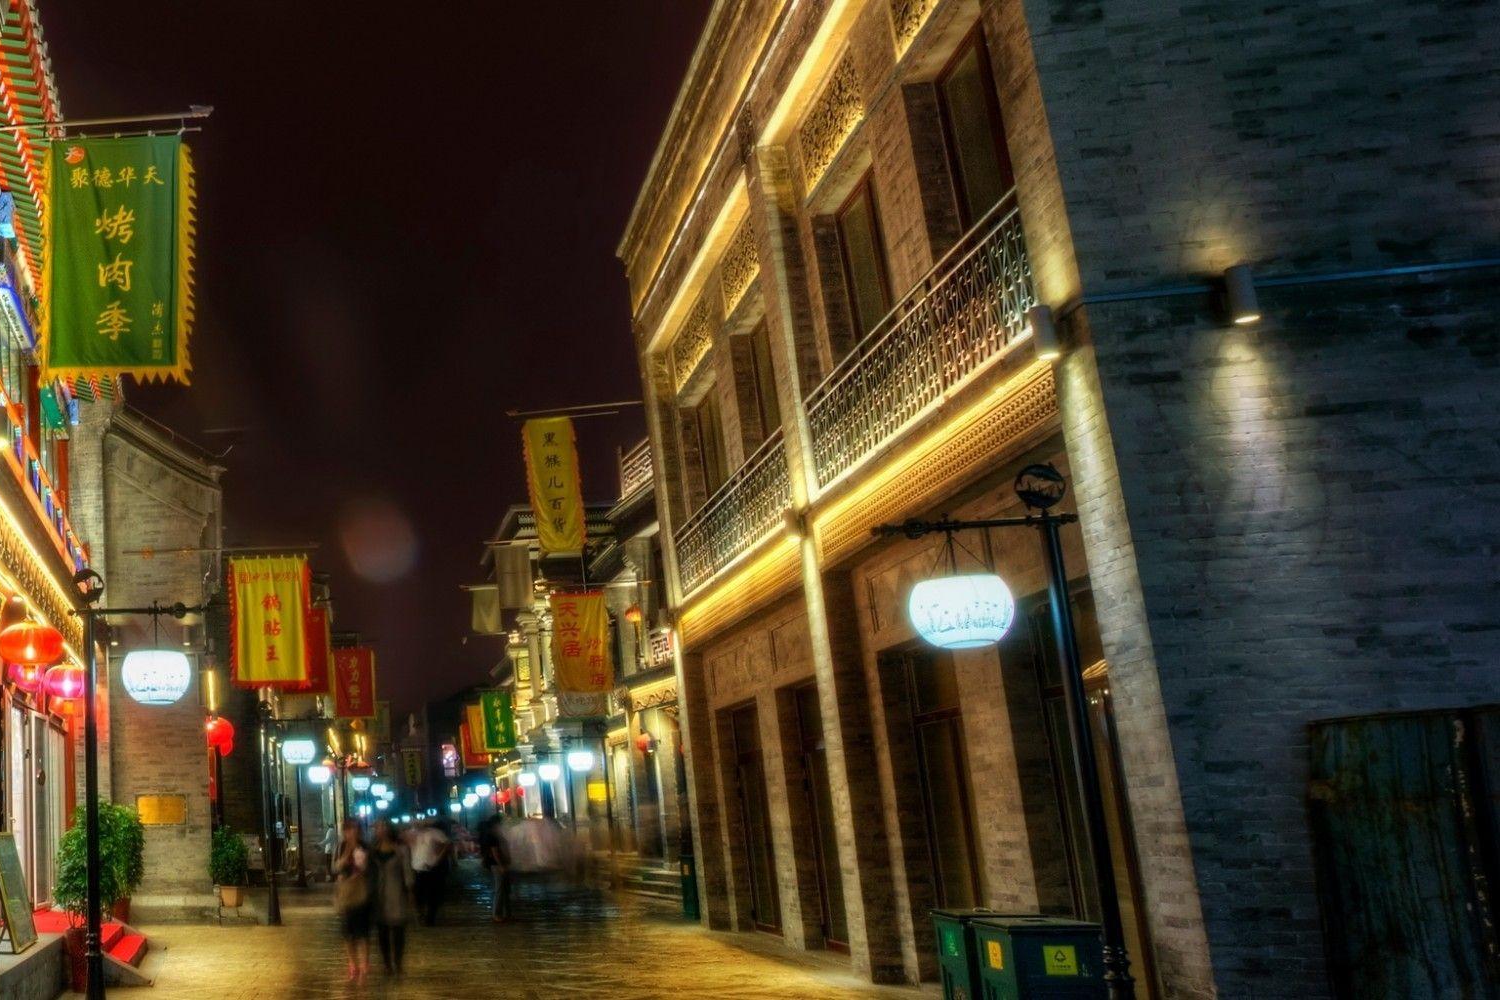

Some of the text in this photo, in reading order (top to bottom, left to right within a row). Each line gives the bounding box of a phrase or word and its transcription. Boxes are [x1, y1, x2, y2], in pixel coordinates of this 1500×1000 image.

[70, 165, 165, 189] 聚德华天
[95, 204, 135, 341] 烤肉季
